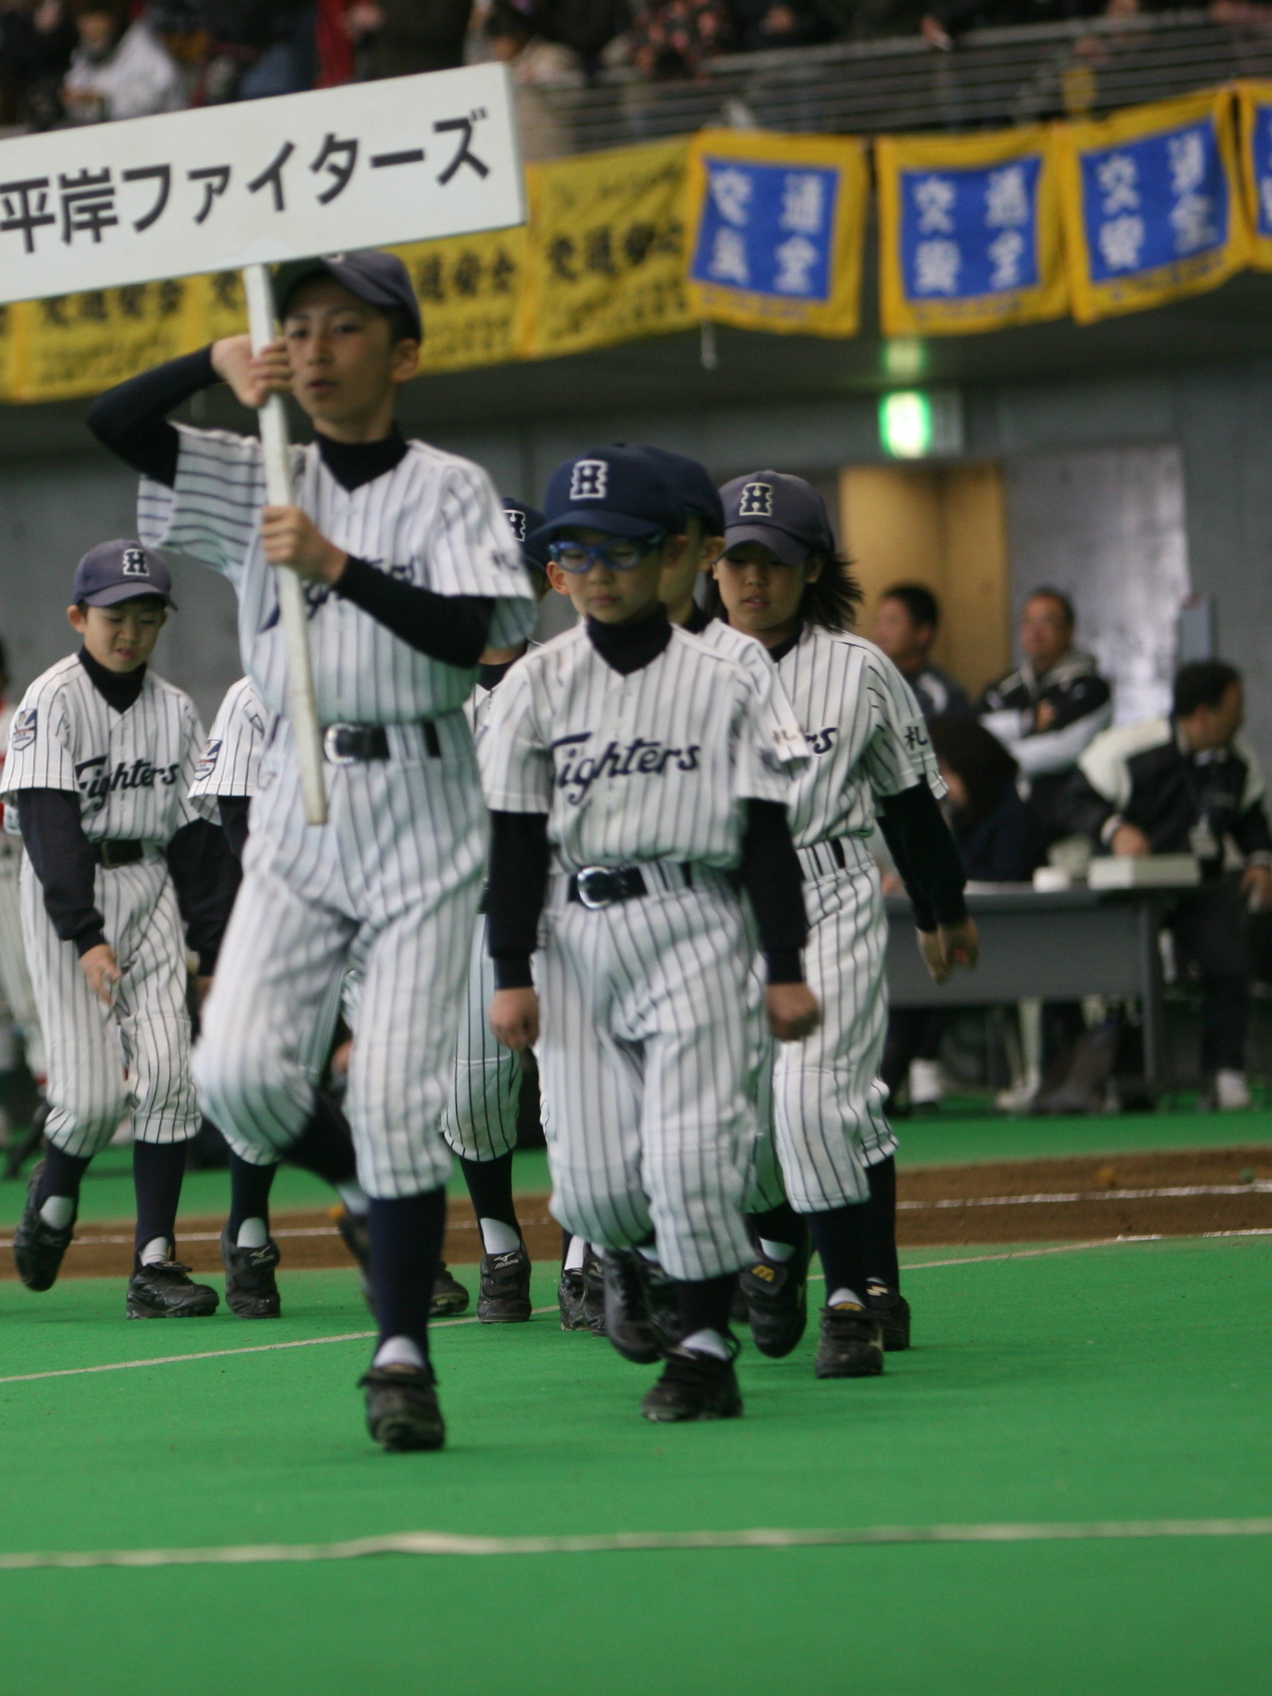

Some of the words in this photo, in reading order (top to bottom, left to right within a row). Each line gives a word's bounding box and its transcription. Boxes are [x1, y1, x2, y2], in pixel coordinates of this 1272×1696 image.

[570, 459, 608, 499] H
[739, 482, 773, 517] H
[123, 548, 150, 577] H
[75, 754, 179, 812] Fighters
